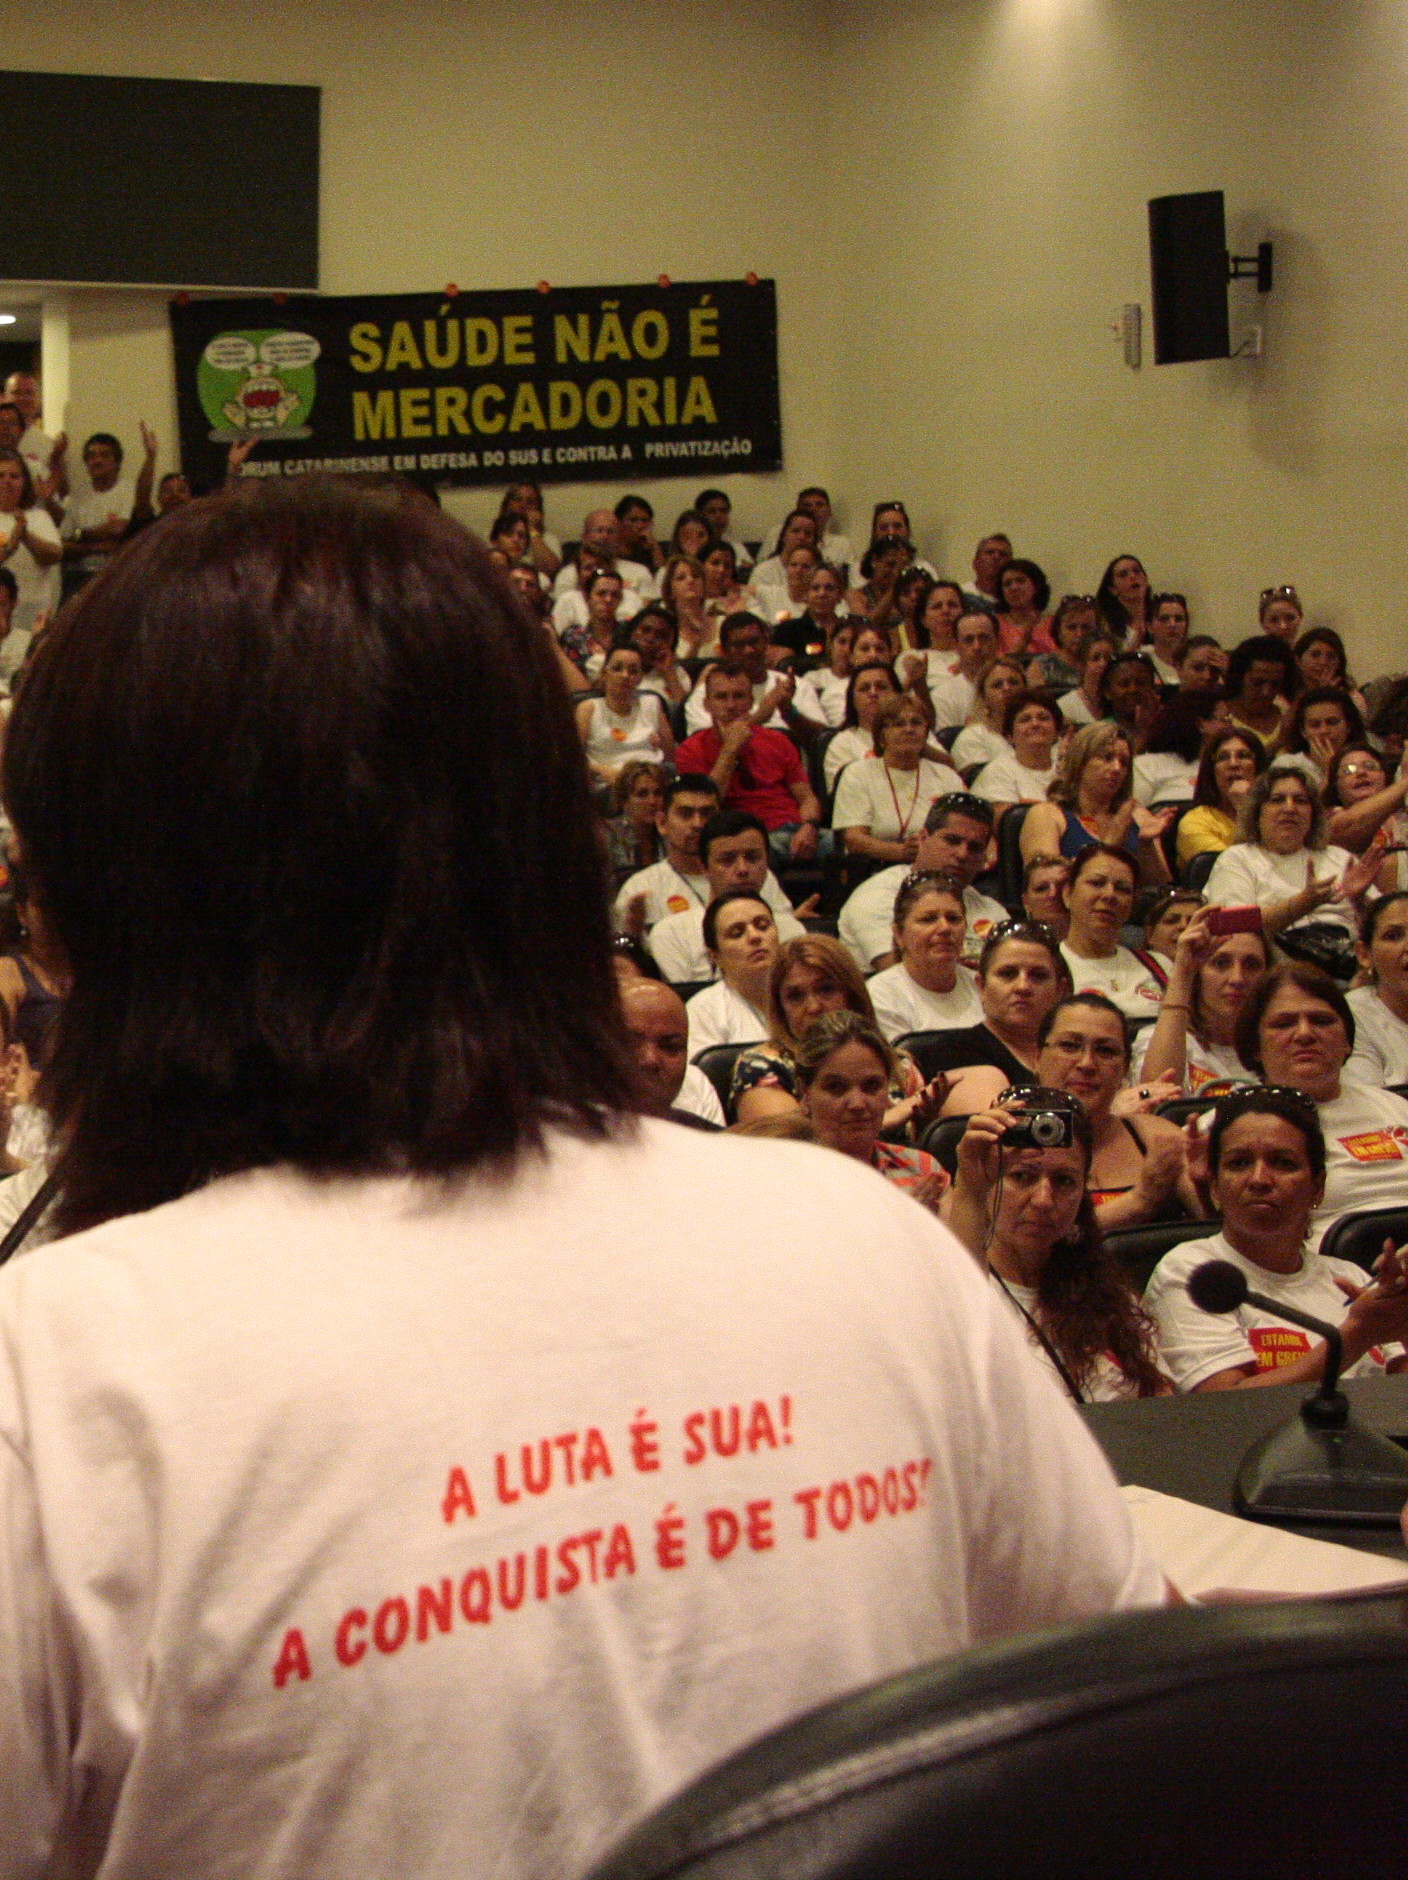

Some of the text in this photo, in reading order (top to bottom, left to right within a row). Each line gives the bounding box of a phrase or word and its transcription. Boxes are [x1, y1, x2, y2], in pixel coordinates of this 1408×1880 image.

[348, 294, 720, 373] SAÚDE NÃO É
[353, 375, 718, 441] MERCADORIA
[419, 451, 479, 470] DEFESA
[482, 449, 505, 467] DO
[508, 448, 538, 465] SUS
[542, 447, 553, 464] E
[555, 444, 619, 463] CONTRA
[620, 443, 633, 460] A
[645, 436, 753, 459] PRIVATIZAÇÃO
[441, 1394, 795, 1524] A LUTA É SUA!
[272, 1457, 935, 1689] A CONQUISTA É DE TODOS!
